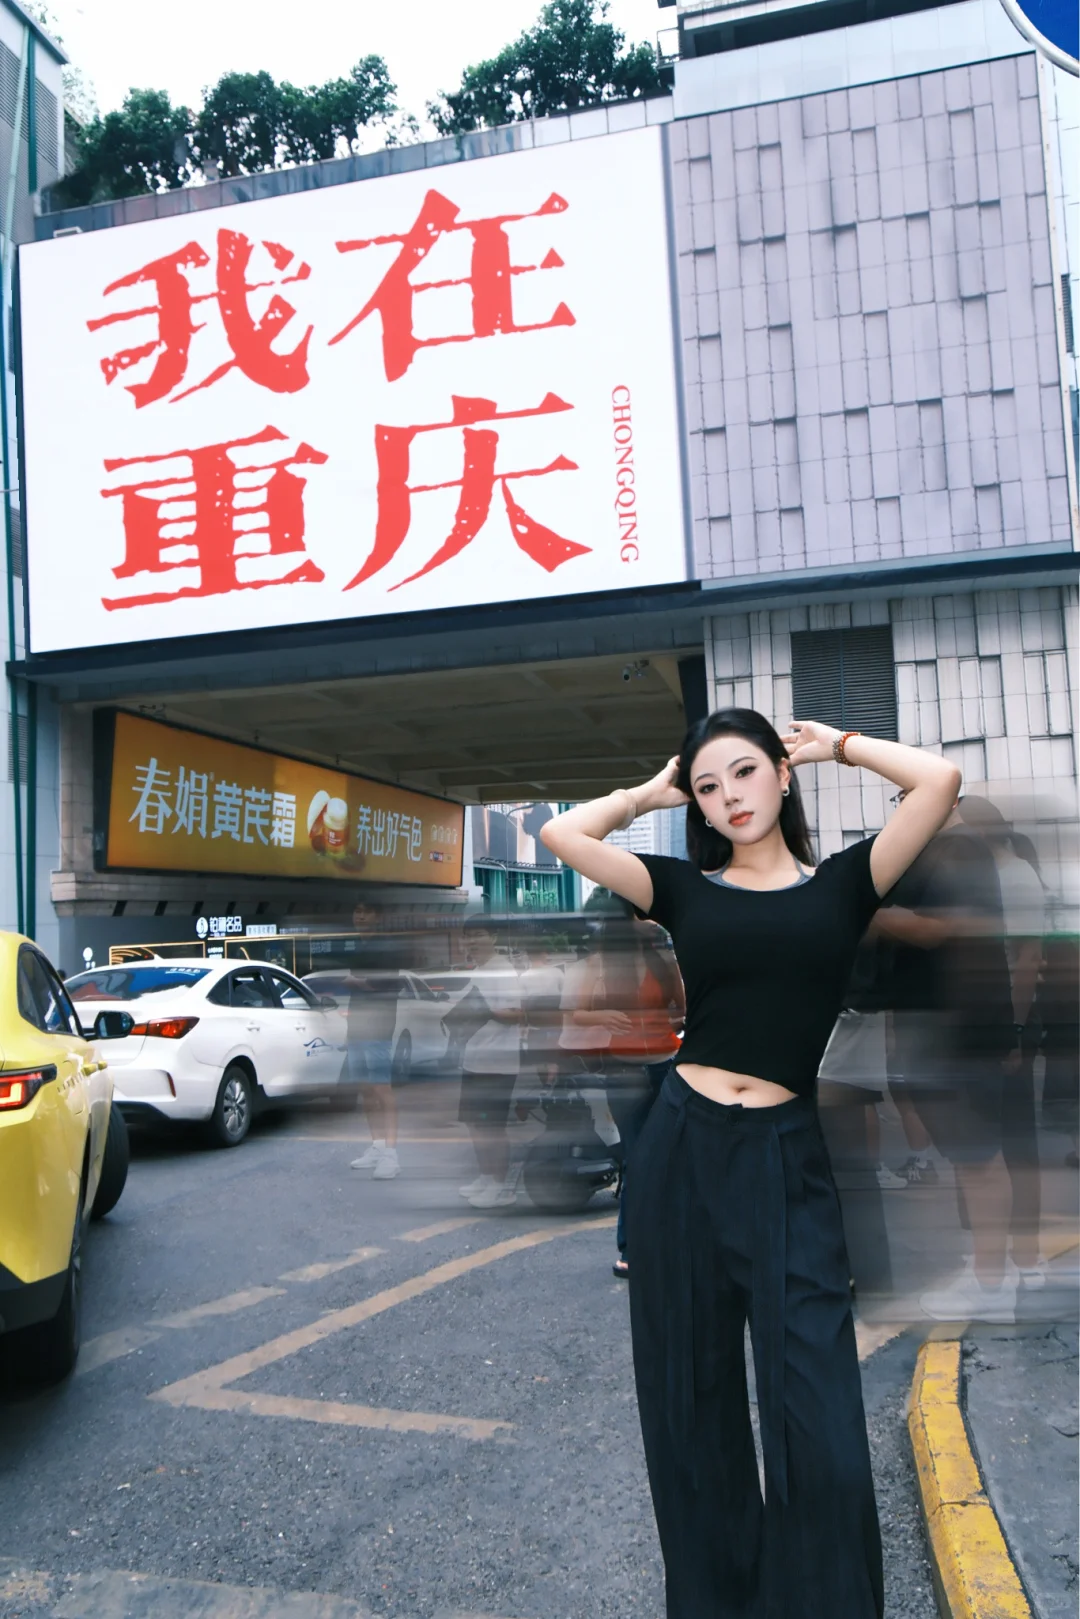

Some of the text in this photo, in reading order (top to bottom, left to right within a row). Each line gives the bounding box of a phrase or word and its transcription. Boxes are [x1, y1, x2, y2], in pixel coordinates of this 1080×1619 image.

[87, 190, 576, 408] 我在
[101, 392, 592, 611] 重庆
[611, 385, 640, 563] CHONGQING
[357, 804, 423, 862] 养出好气色
